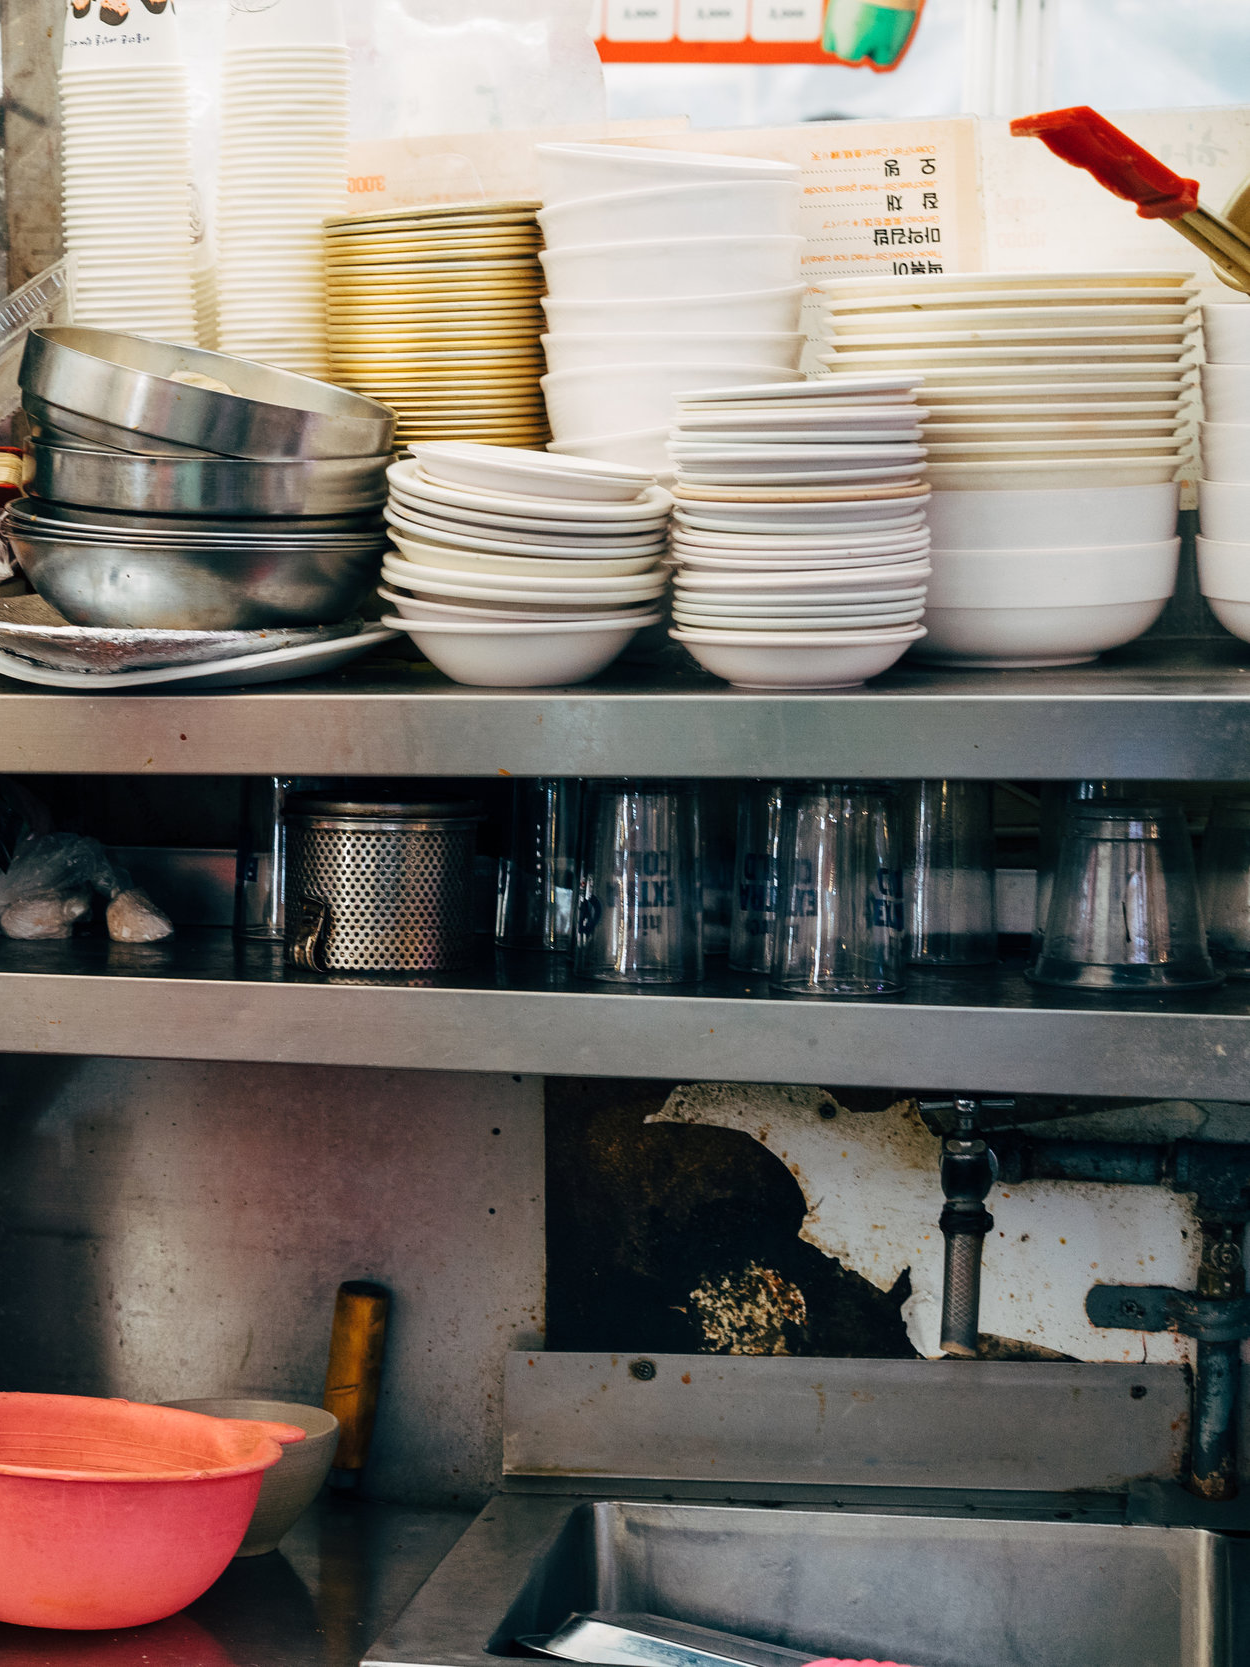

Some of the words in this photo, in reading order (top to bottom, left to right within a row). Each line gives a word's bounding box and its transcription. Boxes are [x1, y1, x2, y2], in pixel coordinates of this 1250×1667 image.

[920, 158, 936, 175] 오
[922, 192, 939, 210] 잡
[873, 227, 941, 246] 마약김밥
